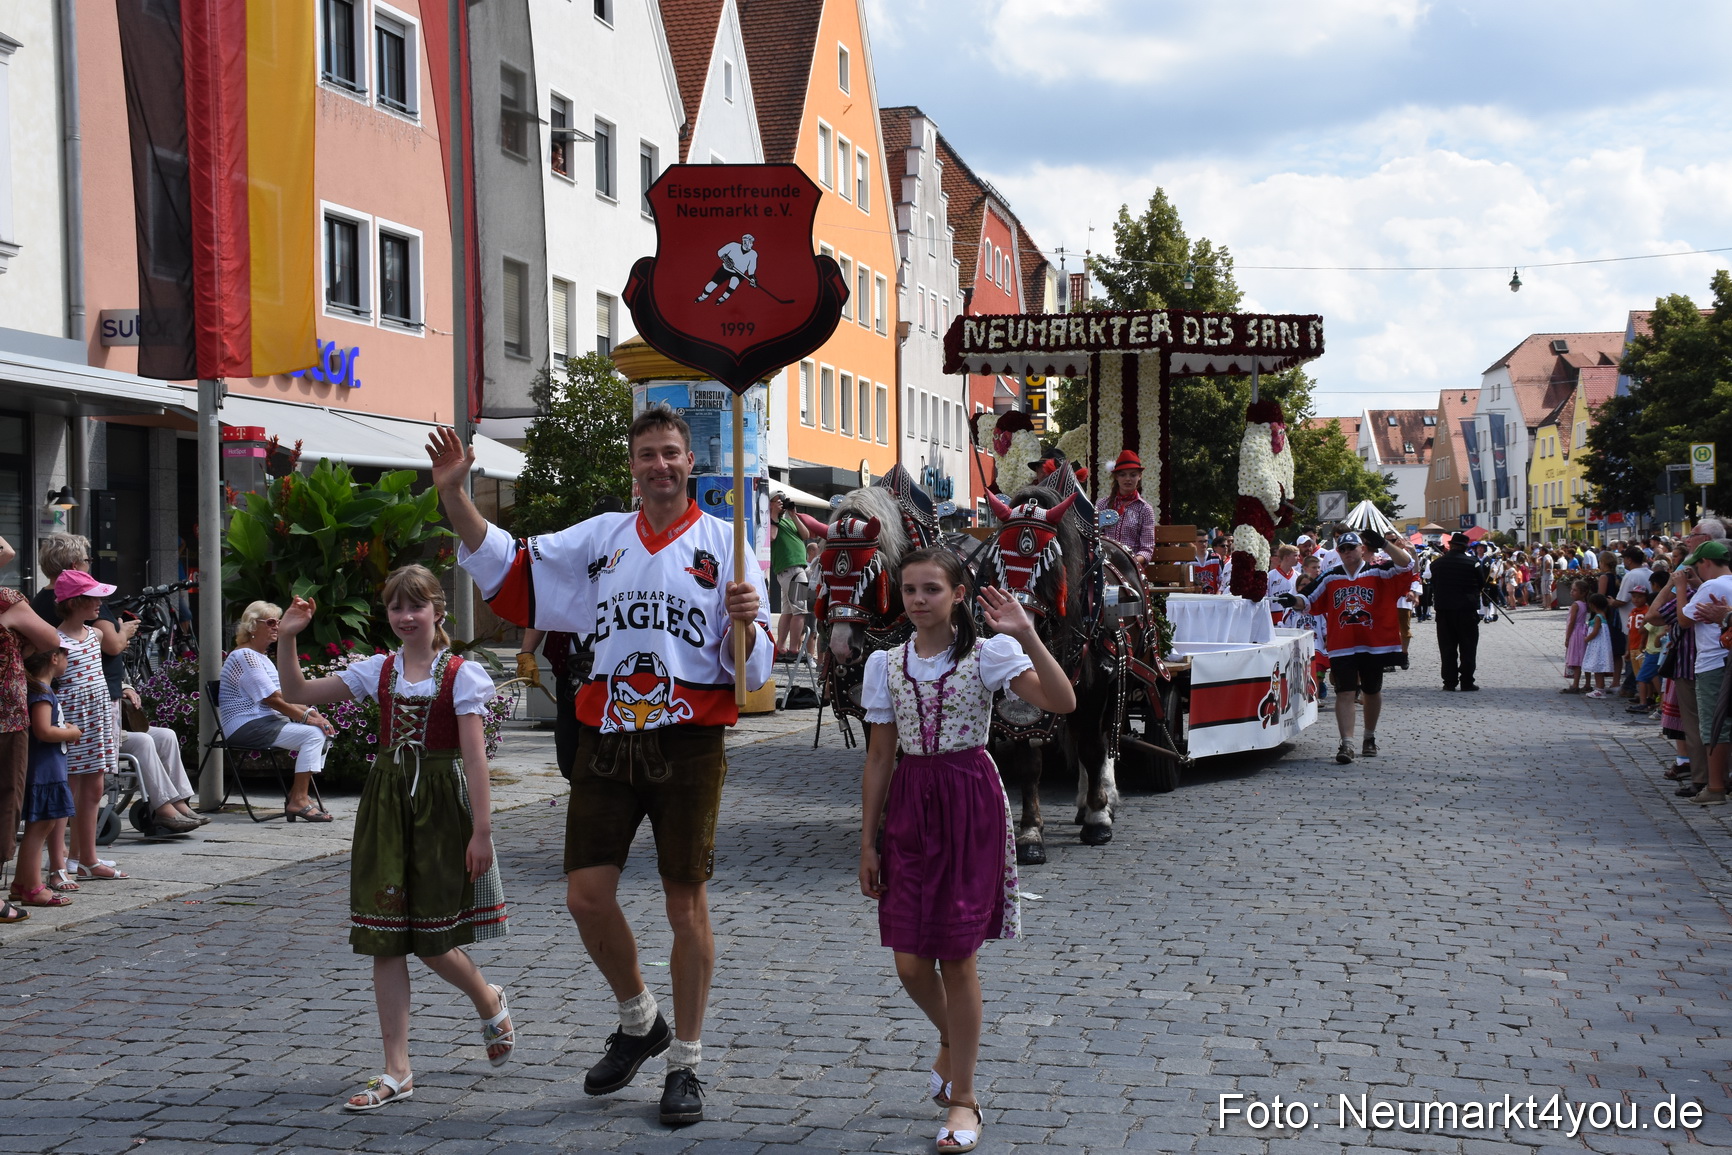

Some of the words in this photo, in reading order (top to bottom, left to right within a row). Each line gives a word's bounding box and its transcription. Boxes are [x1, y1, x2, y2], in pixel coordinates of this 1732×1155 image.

[667, 183, 801, 201] Eissportfreunde
[676, 203, 758, 218] Neumarkt
[720, 322, 756, 336] 1999
[962, 311, 1174, 350] NEUMARKTER
[1182, 315, 1234, 346] DES
[1244, 317, 1300, 350] SAN
[694, 390, 726, 400] CHRISTIAN
[694, 399, 724, 408] SPRINGER
[1698, 449, 1708, 459] H
[611, 591, 686, 608] NEUMARKT
[595, 601, 707, 648] EAGLES
